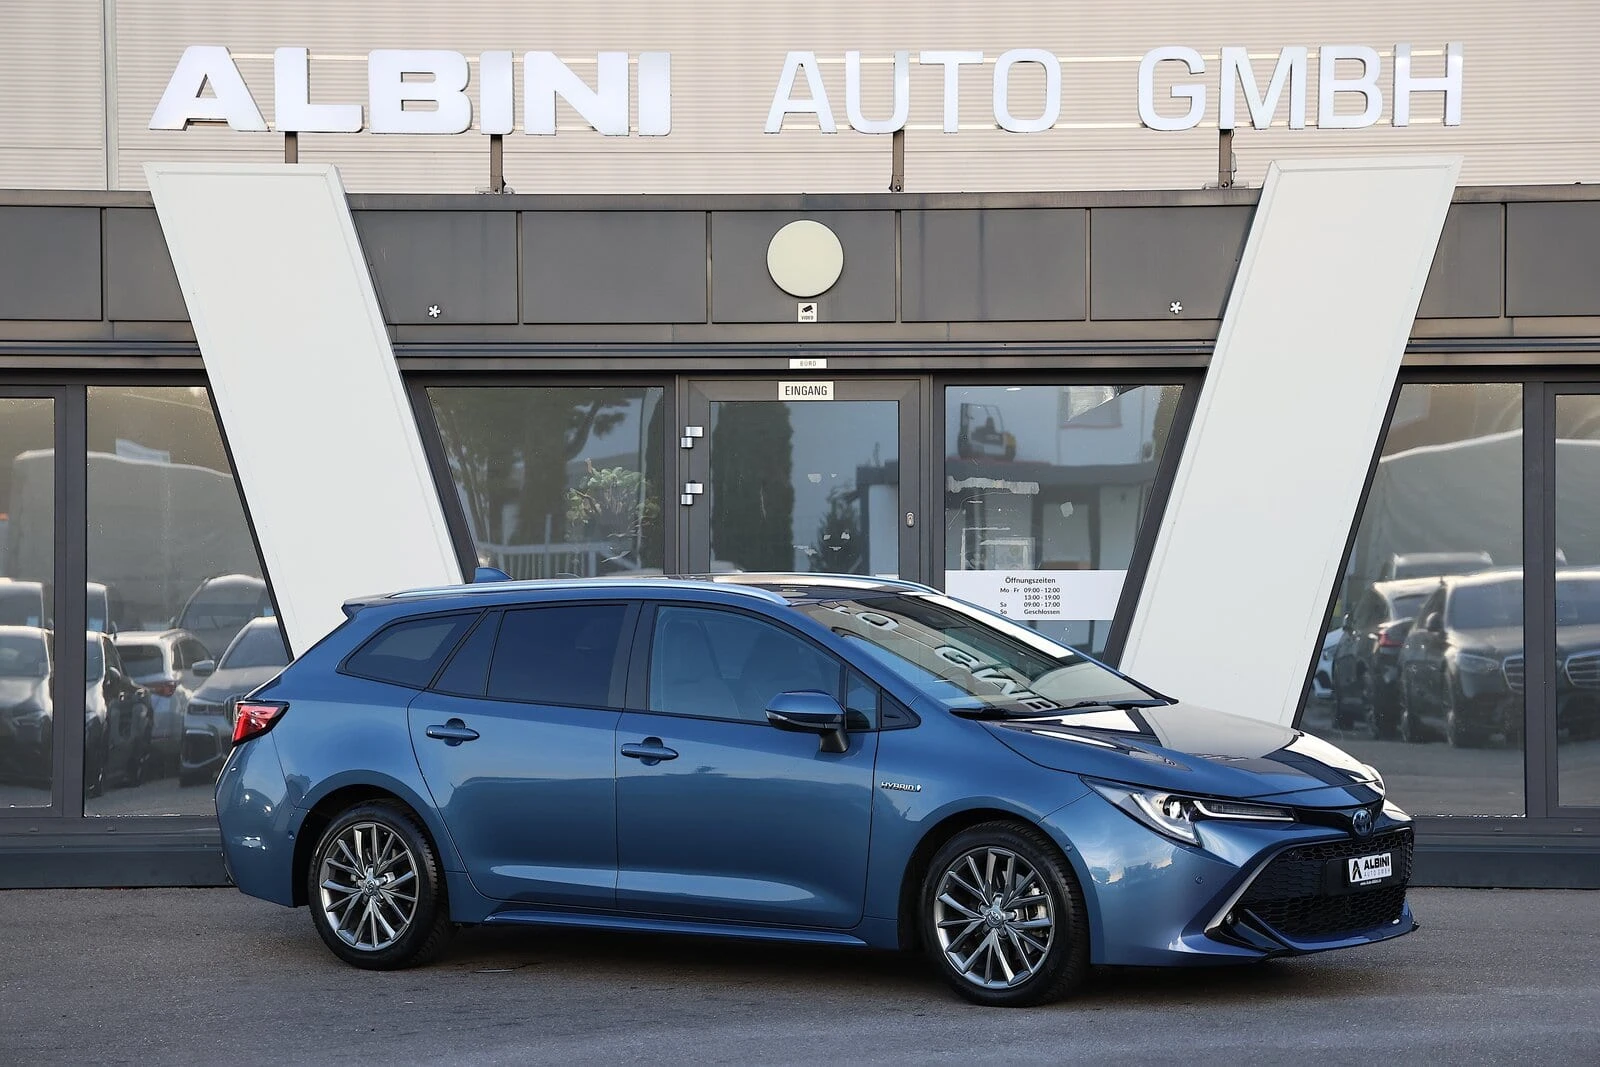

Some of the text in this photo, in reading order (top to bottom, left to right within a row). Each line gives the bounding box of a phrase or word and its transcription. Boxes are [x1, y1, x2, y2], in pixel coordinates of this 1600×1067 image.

[149, 42, 1465, 136] ALBINI AUTO GMBH
[785, 385, 828, 396] EINGANG
[1005, 576, 1056, 585] Öffnungszeiten
[881, 782, 915, 790] HYBRID
[1364, 856, 1389, 870] ALBINI
